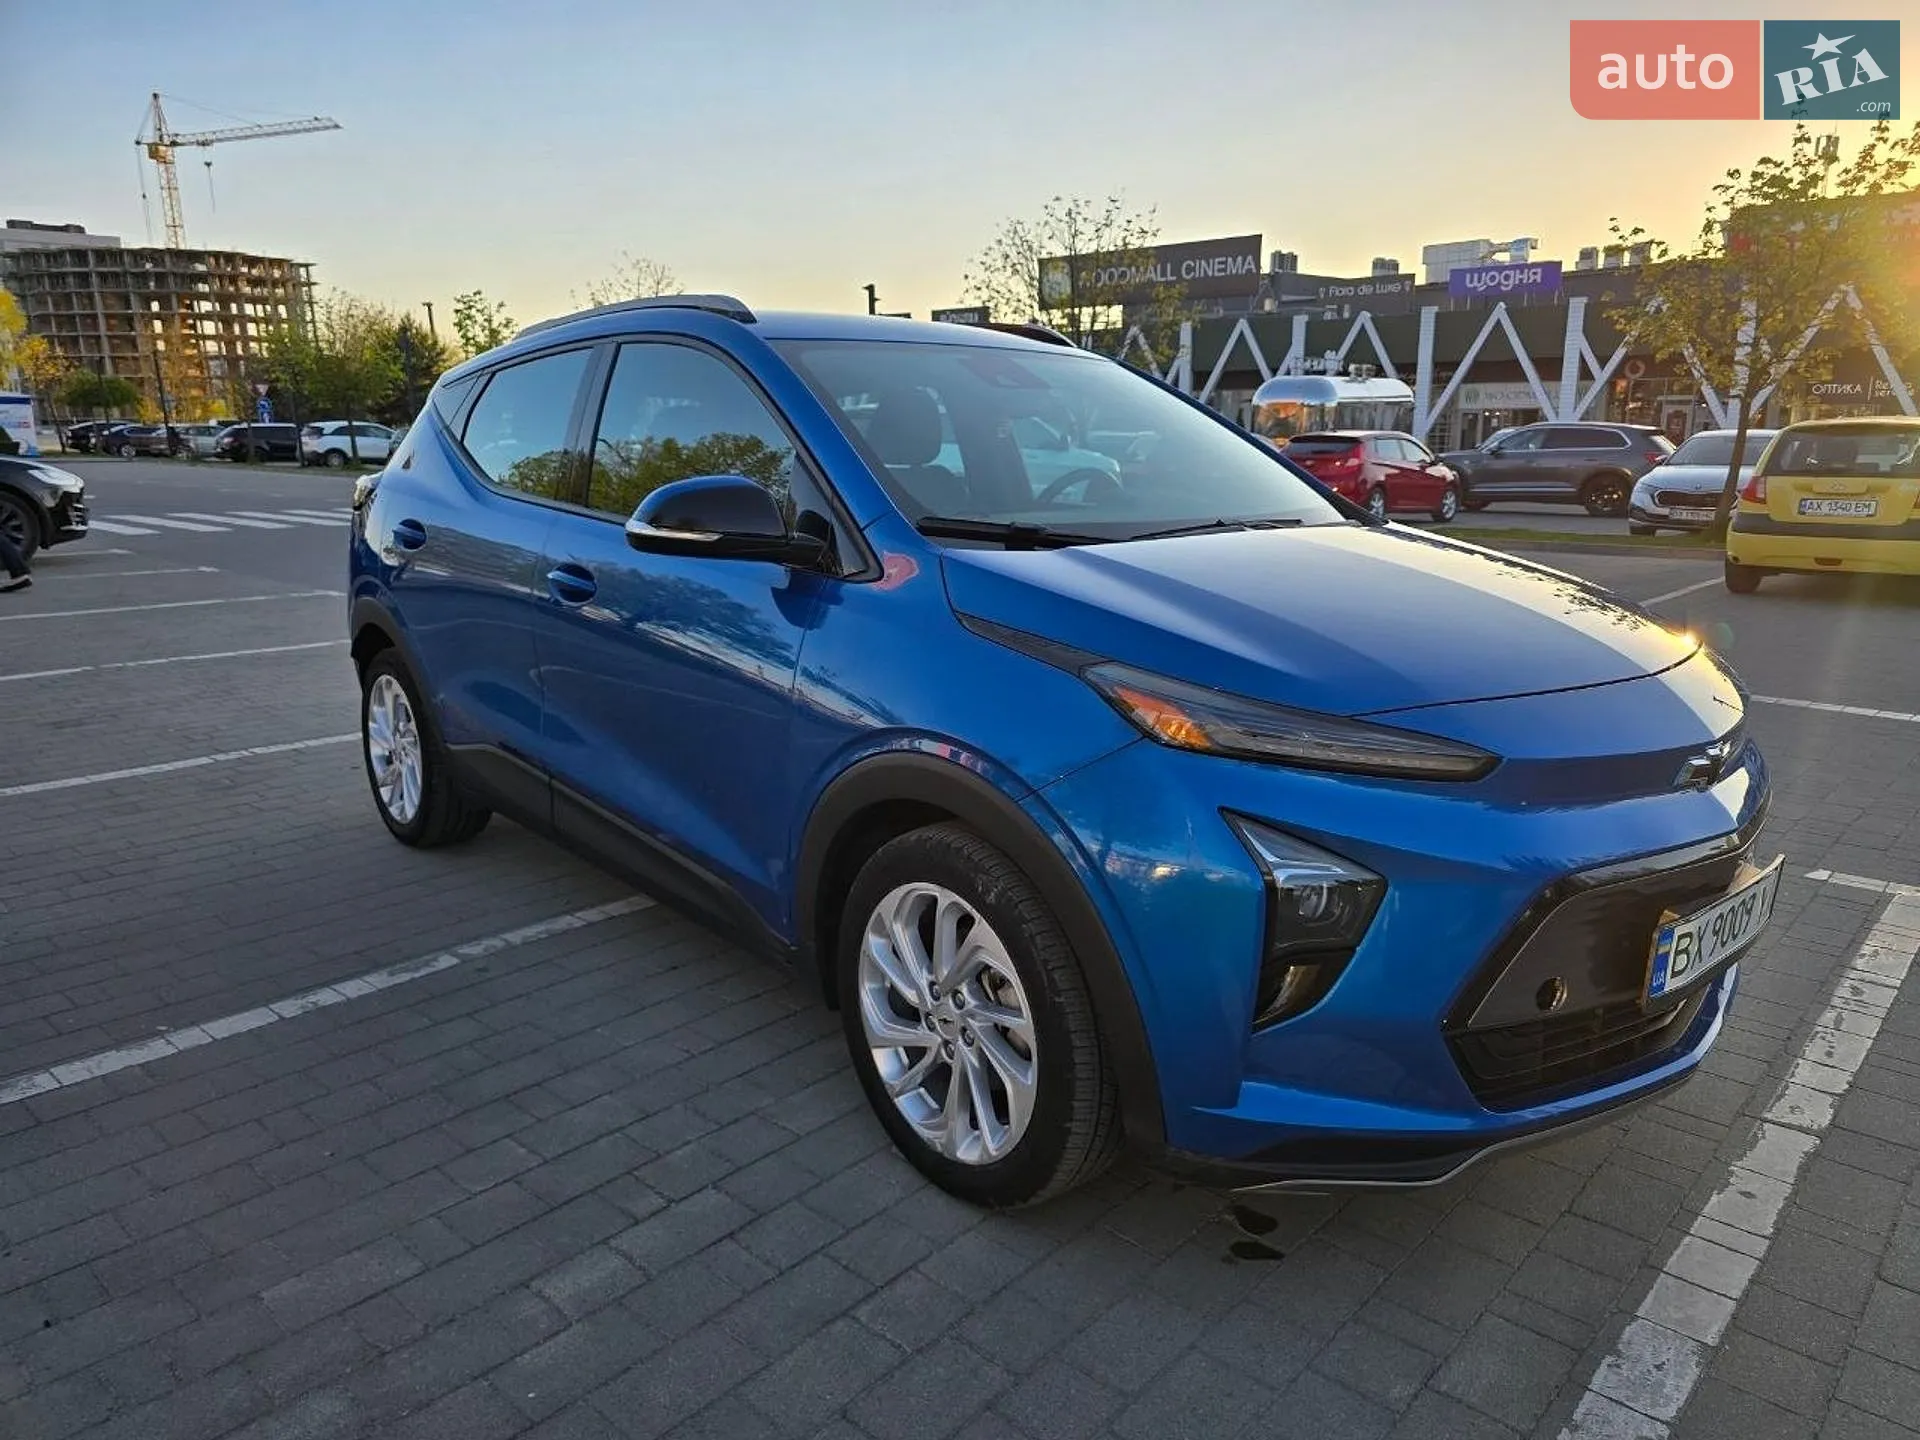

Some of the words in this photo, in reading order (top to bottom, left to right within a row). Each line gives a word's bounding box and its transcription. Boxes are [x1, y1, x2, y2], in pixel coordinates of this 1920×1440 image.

[1181, 255, 1256, 278] CINEMA
[1465, 267, 1542, 292] щодня
[1812, 383, 1862, 395] ОПТИКА
[1670, 919, 1710, 979] BX
[1709, 892, 1756, 958] 9009
